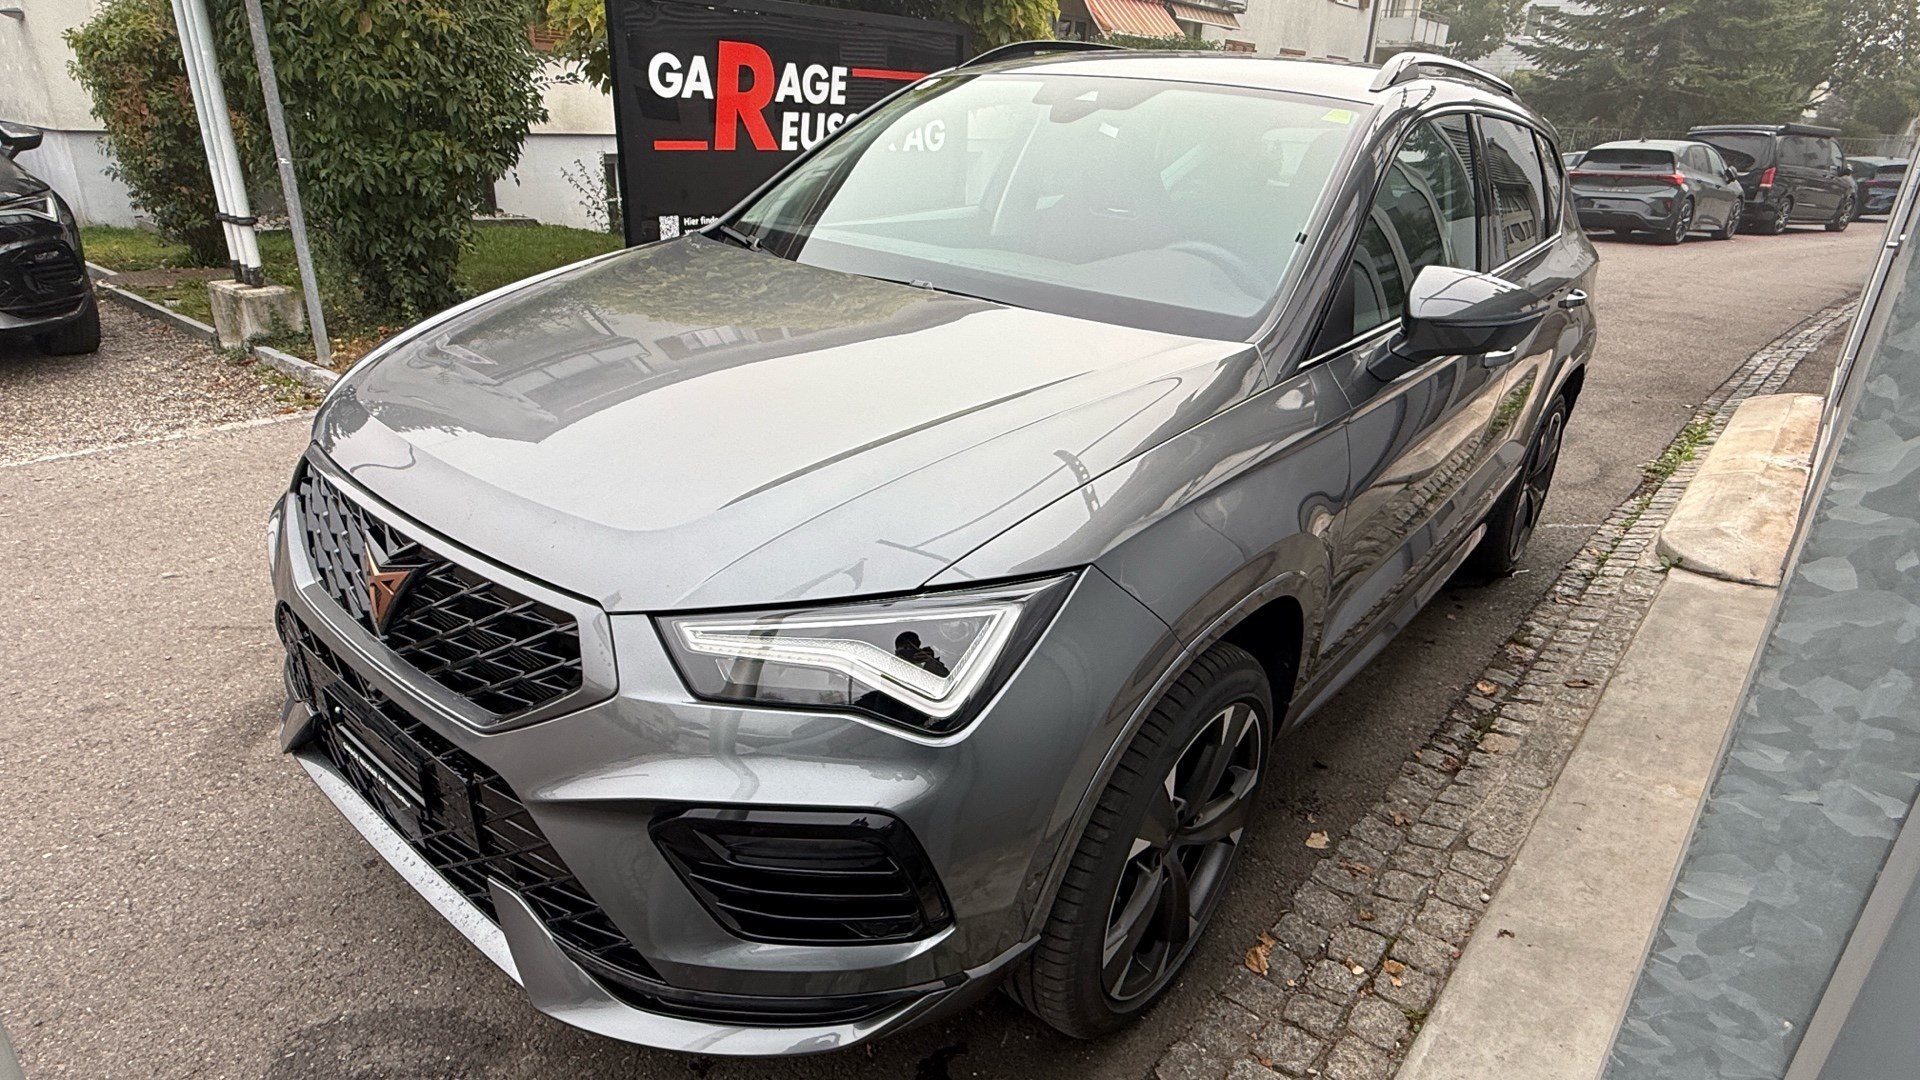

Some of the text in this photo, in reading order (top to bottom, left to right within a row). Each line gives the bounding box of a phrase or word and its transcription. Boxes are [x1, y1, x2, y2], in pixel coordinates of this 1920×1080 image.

[648, 40, 848, 151] GARAGE
[902, 119, 946, 152] AG
[683, 217, 699, 226] Hier
